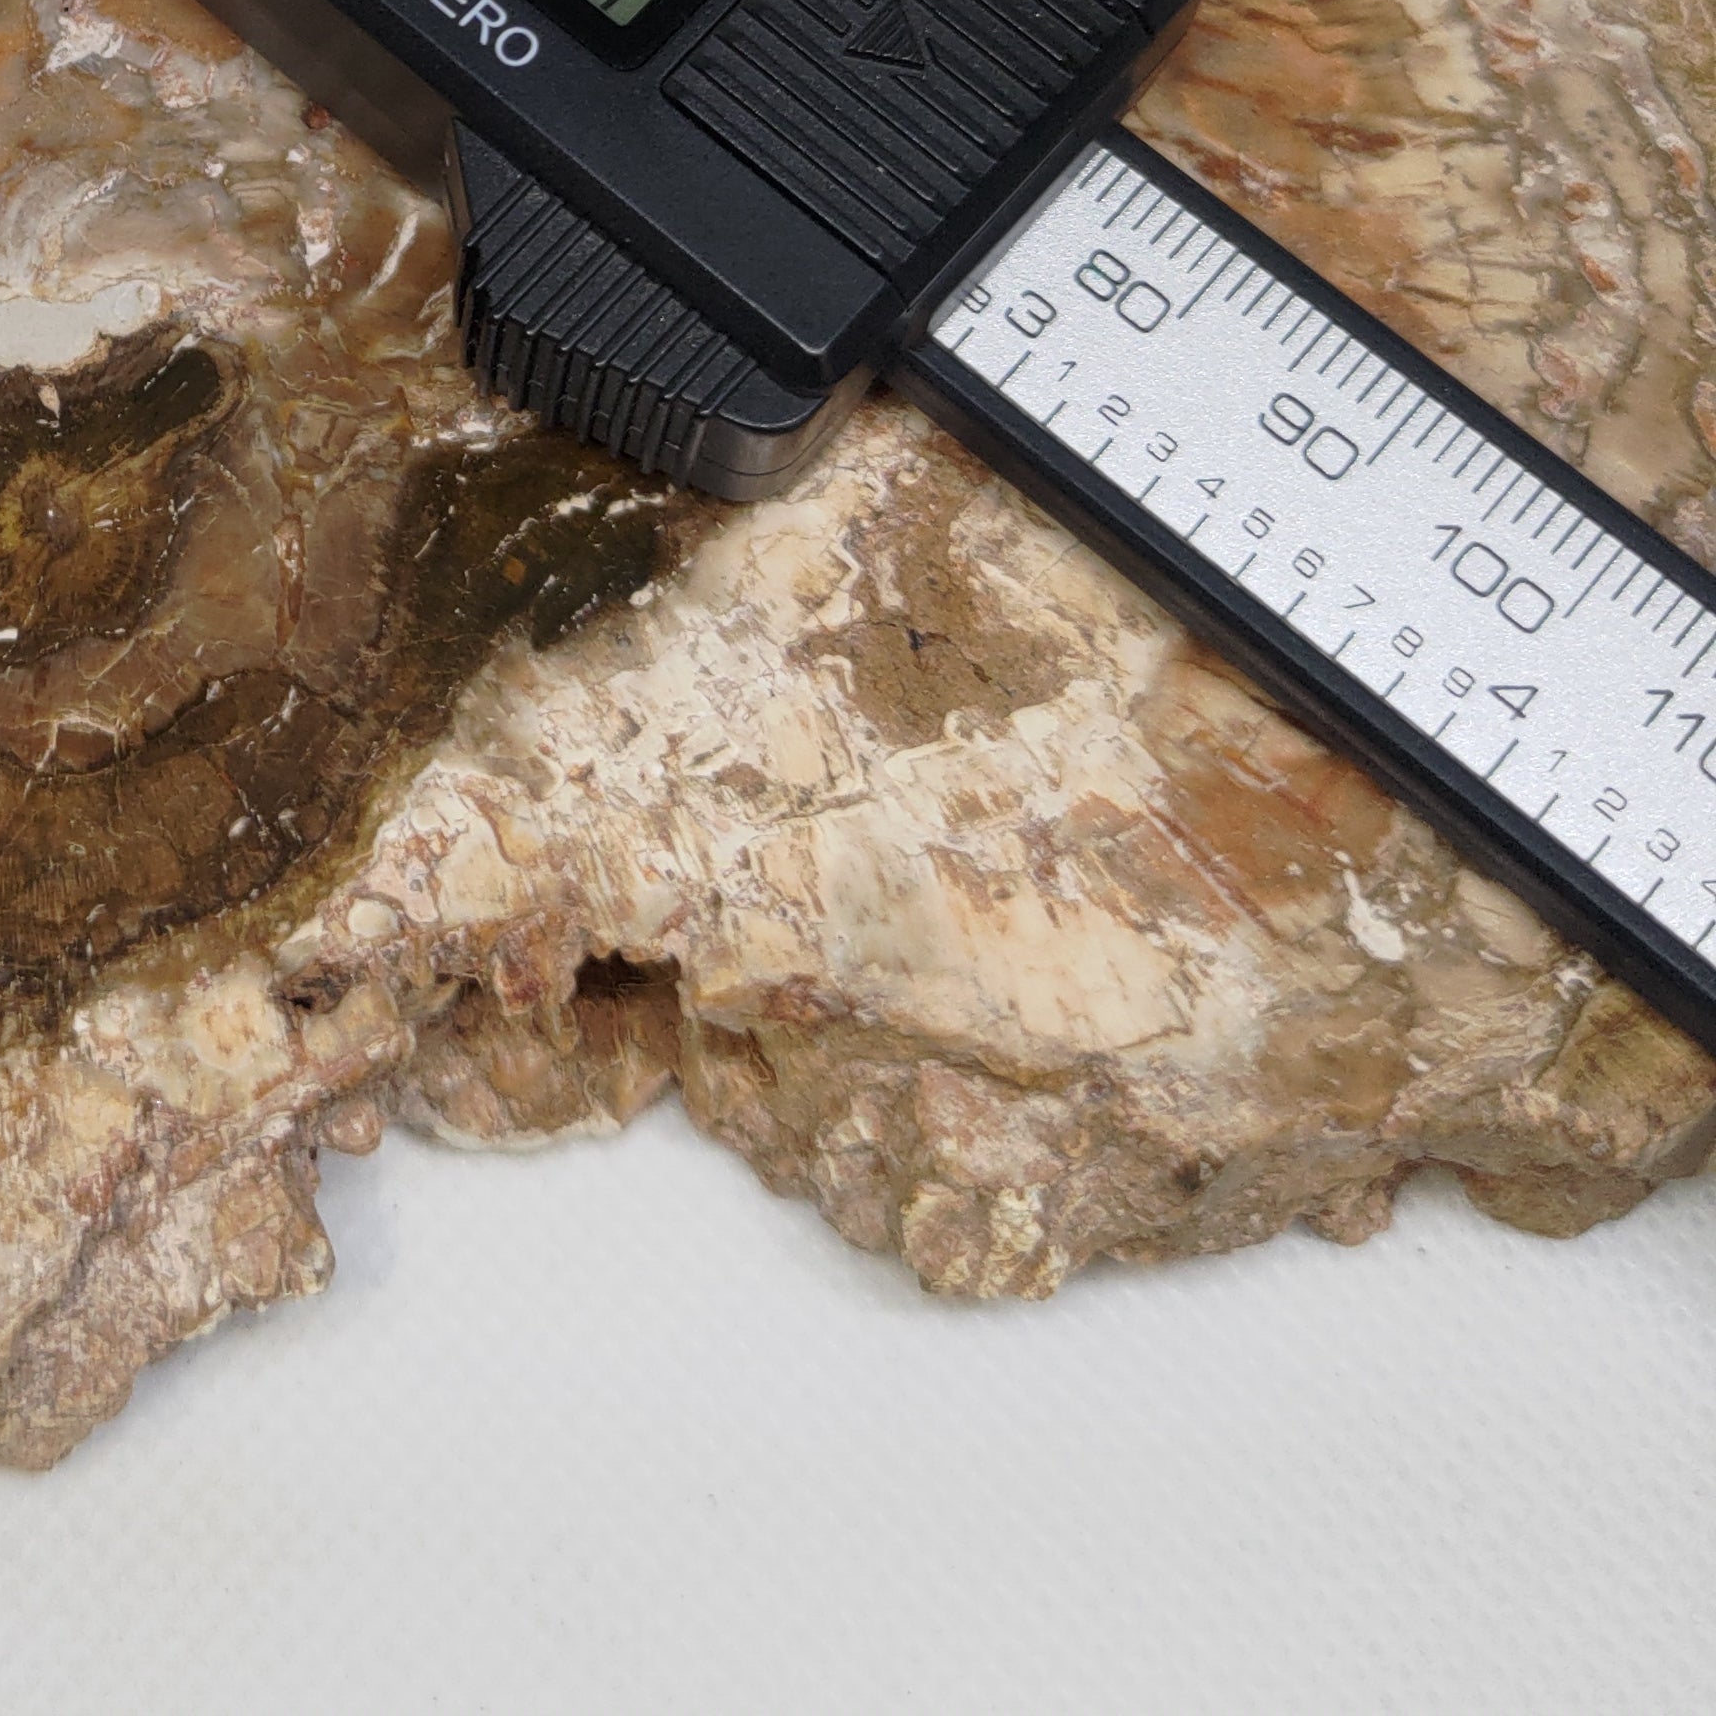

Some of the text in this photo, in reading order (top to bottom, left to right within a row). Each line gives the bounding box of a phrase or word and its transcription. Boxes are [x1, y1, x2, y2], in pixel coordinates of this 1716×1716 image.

[1004, 290, 1057, 339] 3
[1057, 360, 1077, 382] 1
[1097, 394, 1131, 426] 2
[1146, 431, 1178, 462] 3
[1195, 478, 1225, 499] 4
[1241, 507, 1275, 539] 5
[1292, 547, 1325, 579] 6
[1344, 584, 1376, 609] 7
[1392, 626, 1424, 658] 8
[1442, 666, 1476, 698] 9
[1488, 685, 1538, 720] 4
[1548, 750, 1567, 773] 1
[1592, 787, 1627, 822] 2
[1646, 828, 1680, 862] 3
[1074, 248, 1171, 333] 80
[1259, 392, 1359, 480] 90
[1431, 525, 1555, 634] 100
